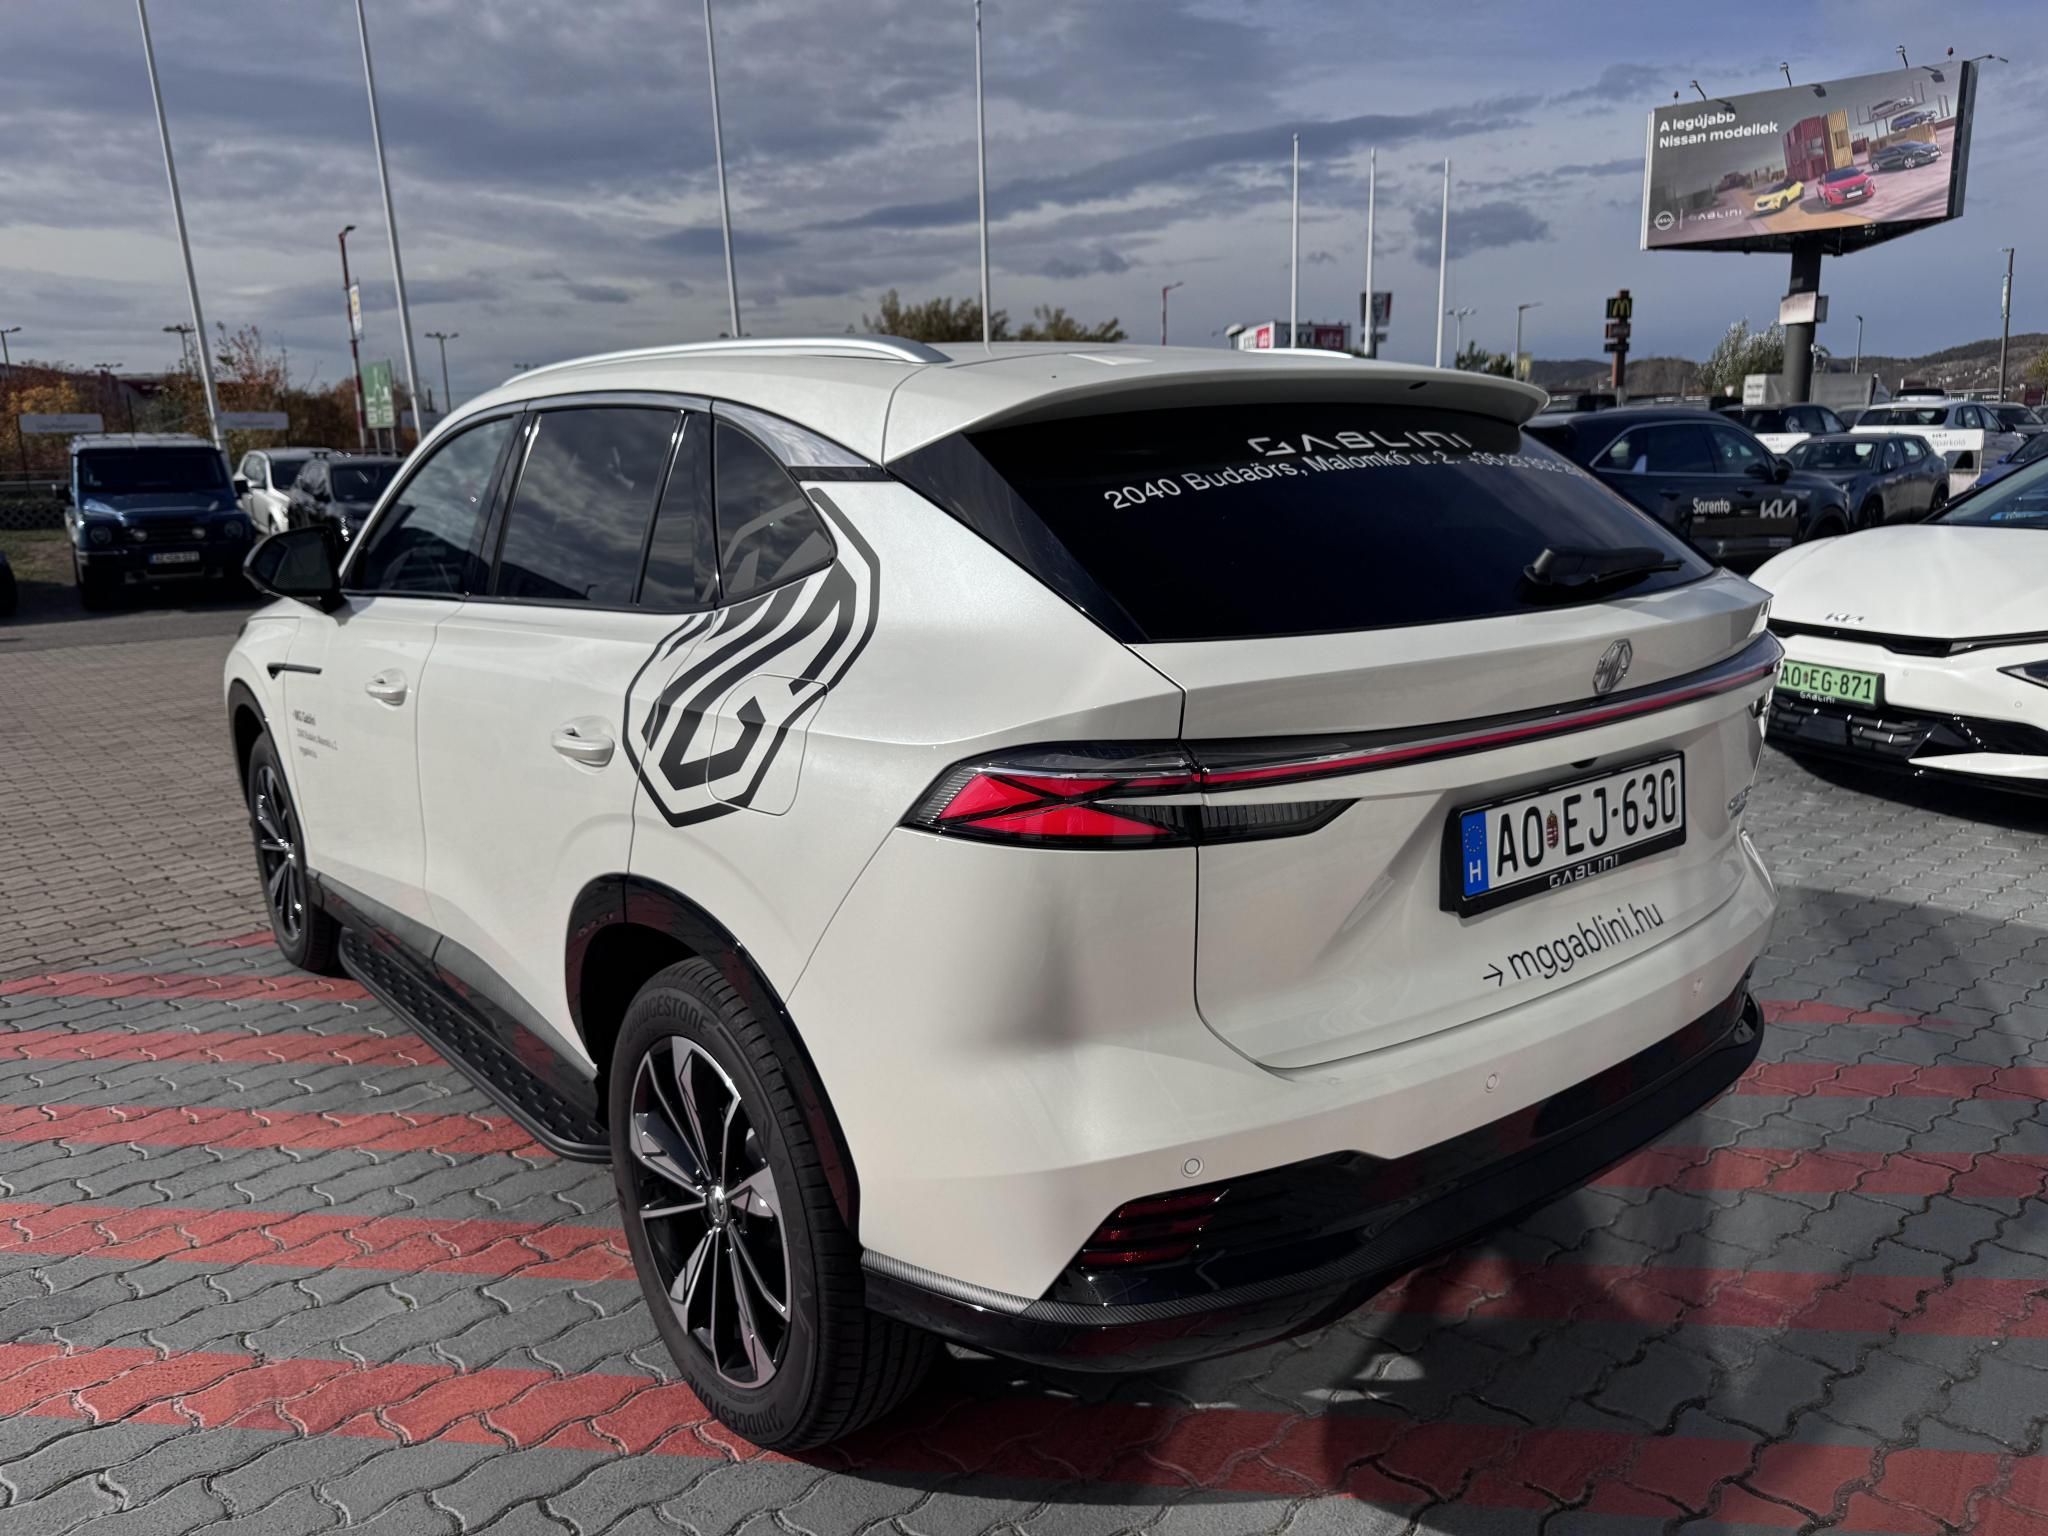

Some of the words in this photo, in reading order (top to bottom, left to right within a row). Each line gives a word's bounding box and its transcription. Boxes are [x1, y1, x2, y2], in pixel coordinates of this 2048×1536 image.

[1659, 132, 1706, 149] Nissan
[1709, 121, 1779, 142] modellek
[1660, 120, 1670, 133] A
[1672, 112, 1736, 131] legújabb
[1104, 478, 1181, 509] 2040
[1181, 462, 1308, 491] Budaörs,
[1692, 497, 1730, 514] Sorento
[1760, 499, 1797, 518] KIA
[1469, 859, 1483, 884] H
[1496, 806, 1545, 878] AO
[1550, 854, 1620, 888] GABLINI
[1507, 902, 1664, 980] mggablini.hu
